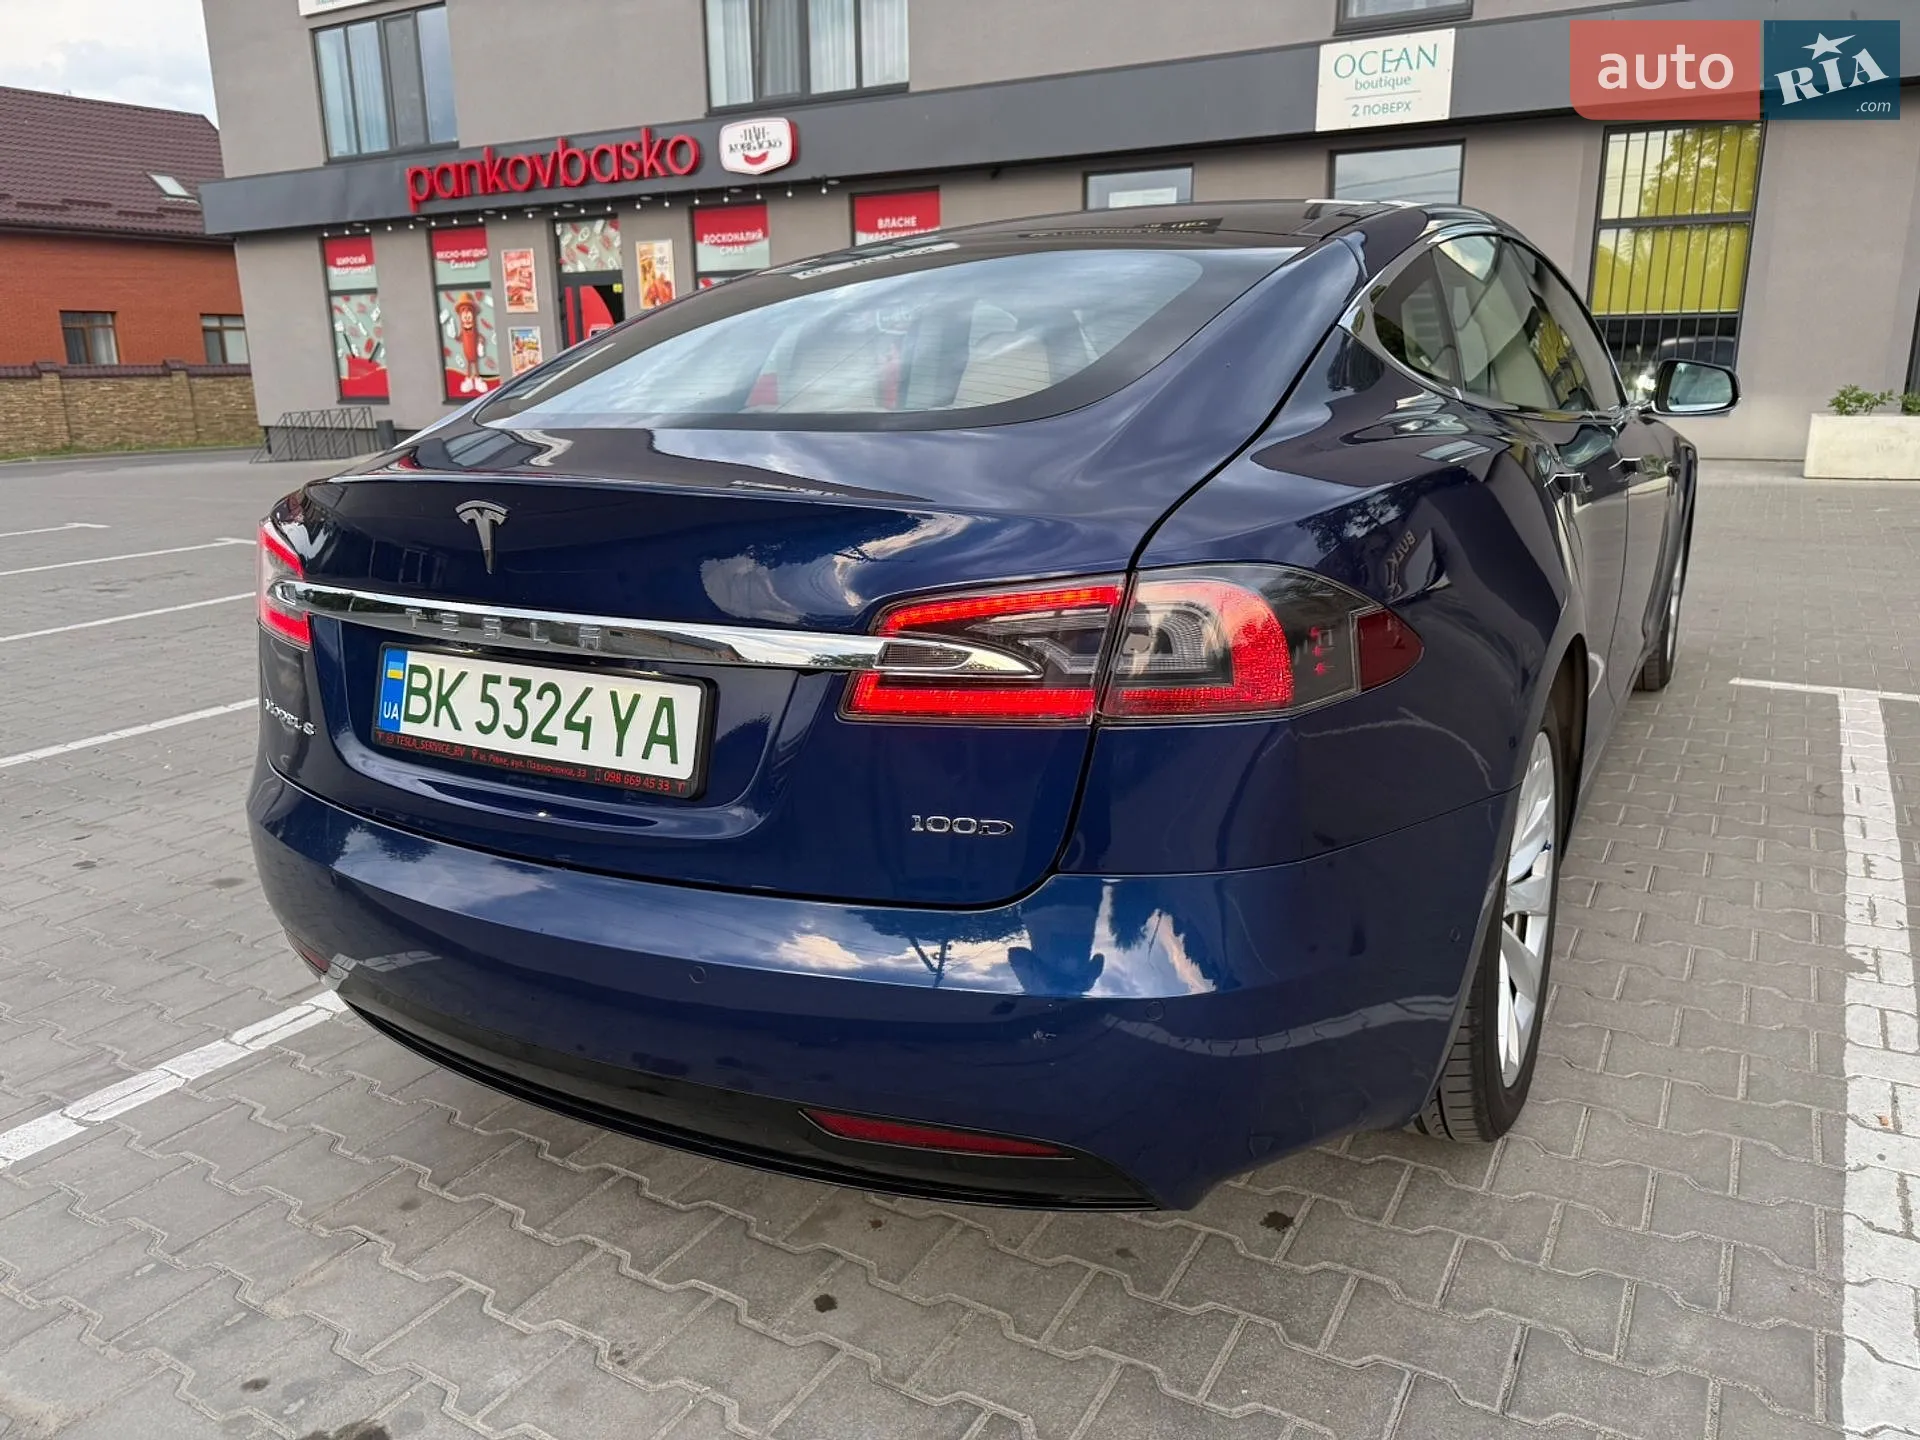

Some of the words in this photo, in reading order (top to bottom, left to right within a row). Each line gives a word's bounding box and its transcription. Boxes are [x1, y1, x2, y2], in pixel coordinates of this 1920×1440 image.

[1334, 43, 1438, 79] OCEAN
[1354, 75, 1412, 91] boutique
[1351, 104, 1360, 118] 2
[1362, 101, 1413, 116] ПОВЕРХ
[405, 126, 701, 213] pankovbasko
[876, 216, 918, 229] ВЛАСНЕ
[702, 228, 764, 245] ДОСКОНАЛИЙ
[382, 700, 400, 721] UA
[475, 672, 595, 751] 5324
[609, 689, 679, 764] YA
[576, 767, 588, 778] 33
[603, 769, 622, 784] 098
[623, 774, 642, 788] 669
[643, 776, 657, 790] 45
[657, 779, 672, 793] 33
[911, 814, 1014, 836] 100D
